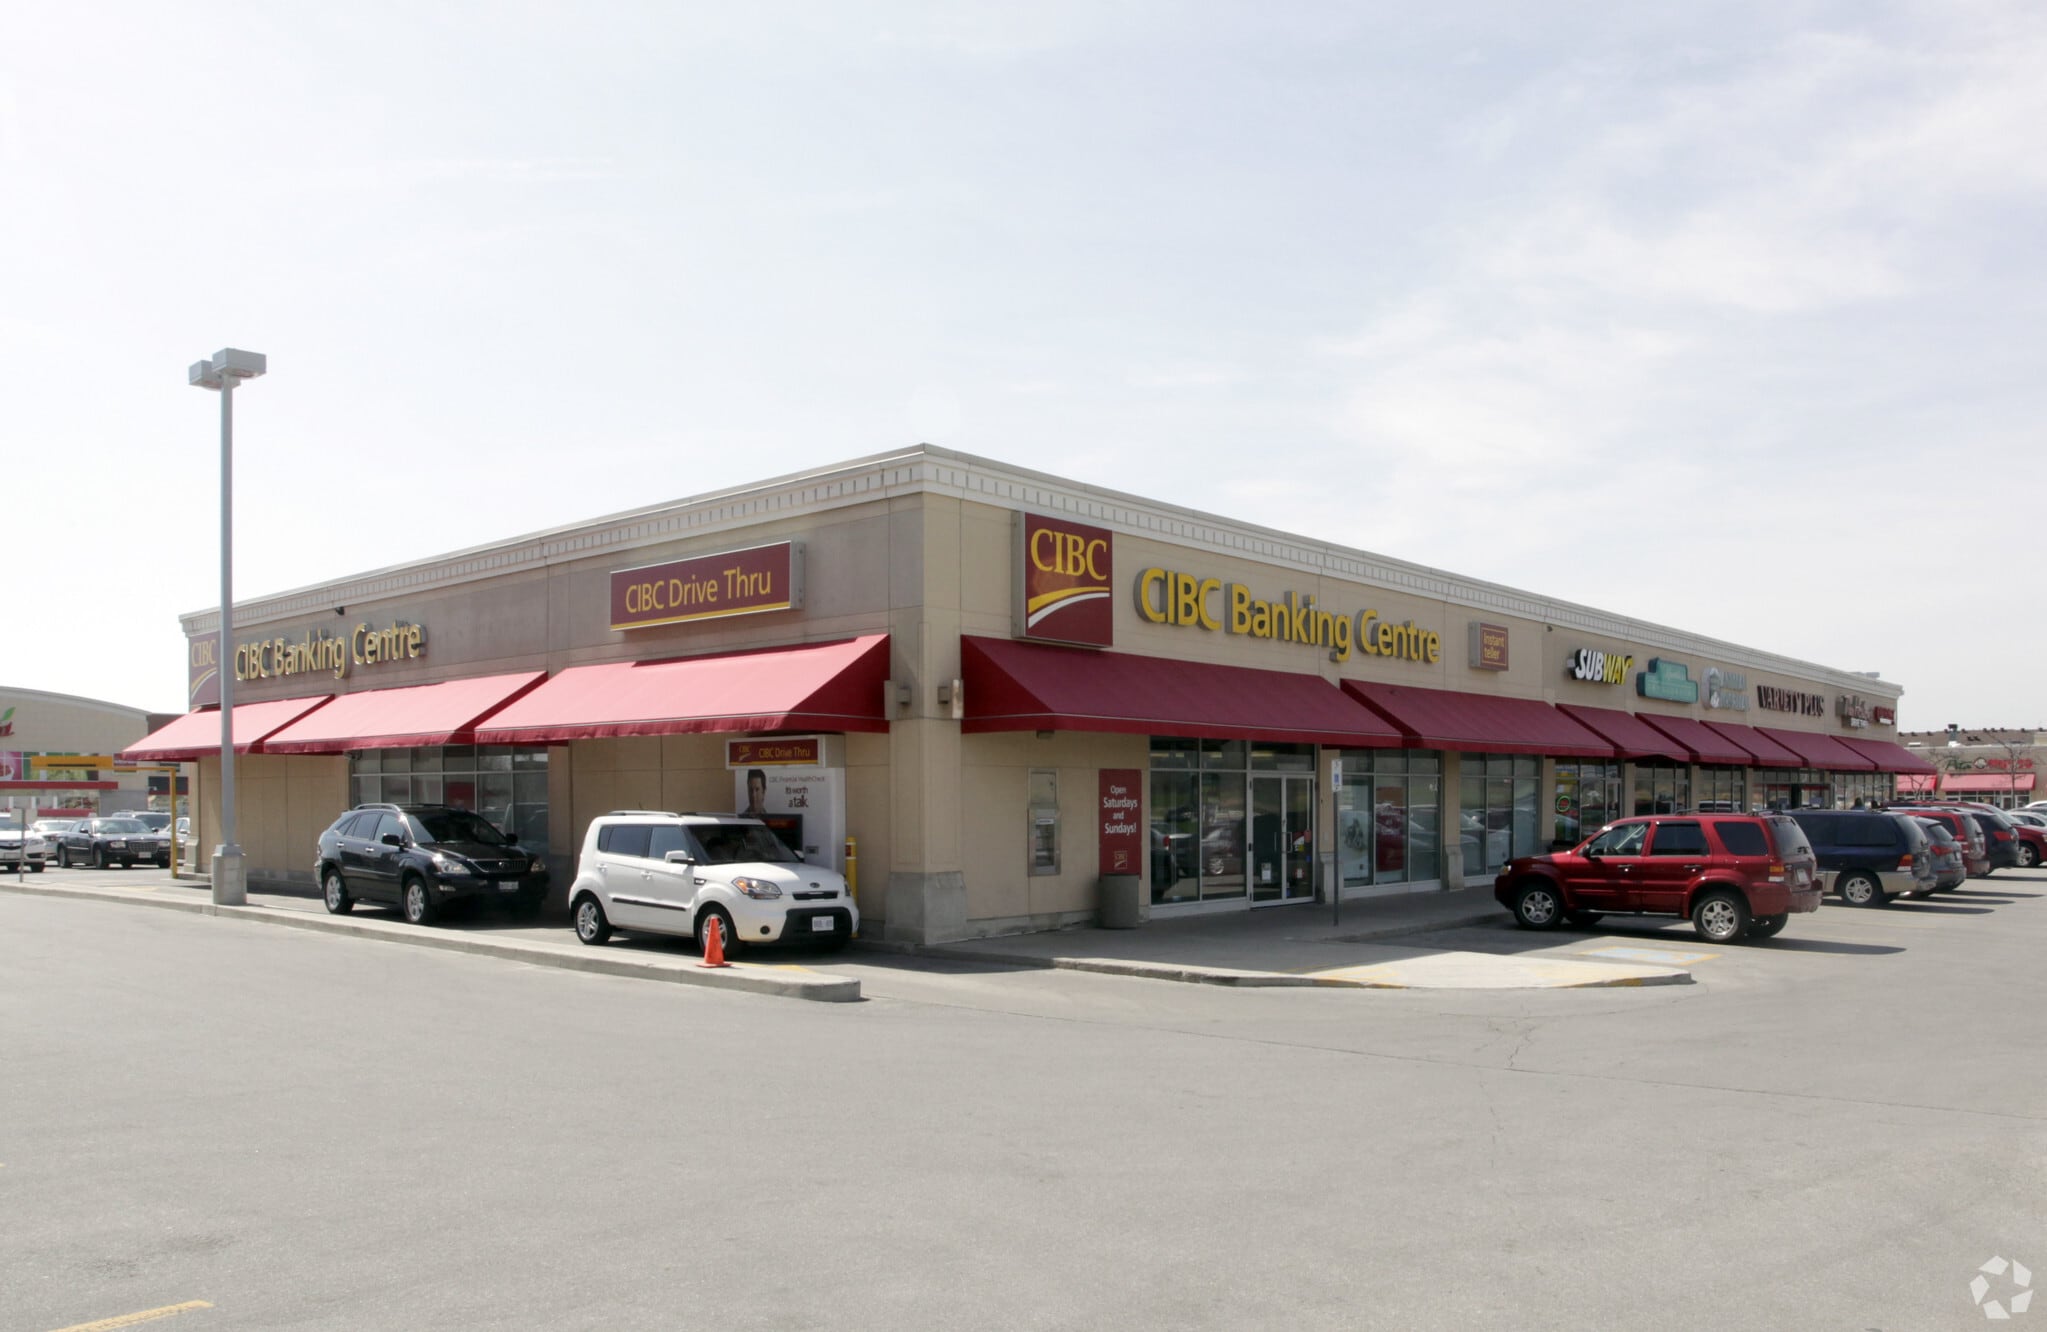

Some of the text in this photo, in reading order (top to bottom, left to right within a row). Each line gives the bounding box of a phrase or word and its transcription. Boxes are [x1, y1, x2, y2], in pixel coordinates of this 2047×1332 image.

[1030, 527, 1108, 582] CIBC
[625, 566, 771, 614] CIBC Drive Thru
[1134, 566, 1441, 664] CIBC Banking Centre
[191, 639, 217, 668] CIBC
[235, 622, 426, 681] CIBC Banking Centre
[1574, 648, 1633, 685] SUBWAY
[1757, 685, 1798, 713] VARIETY
[1800, 693, 1825, 717] PLUS
[759, 746, 811, 758] CIBC Drive Thru
[1103, 797, 1137, 810] Saturdays
[1110, 785, 1127, 795] Open
[1104, 822, 1136, 835] Sundays!
[1112, 811, 1125, 820] and
